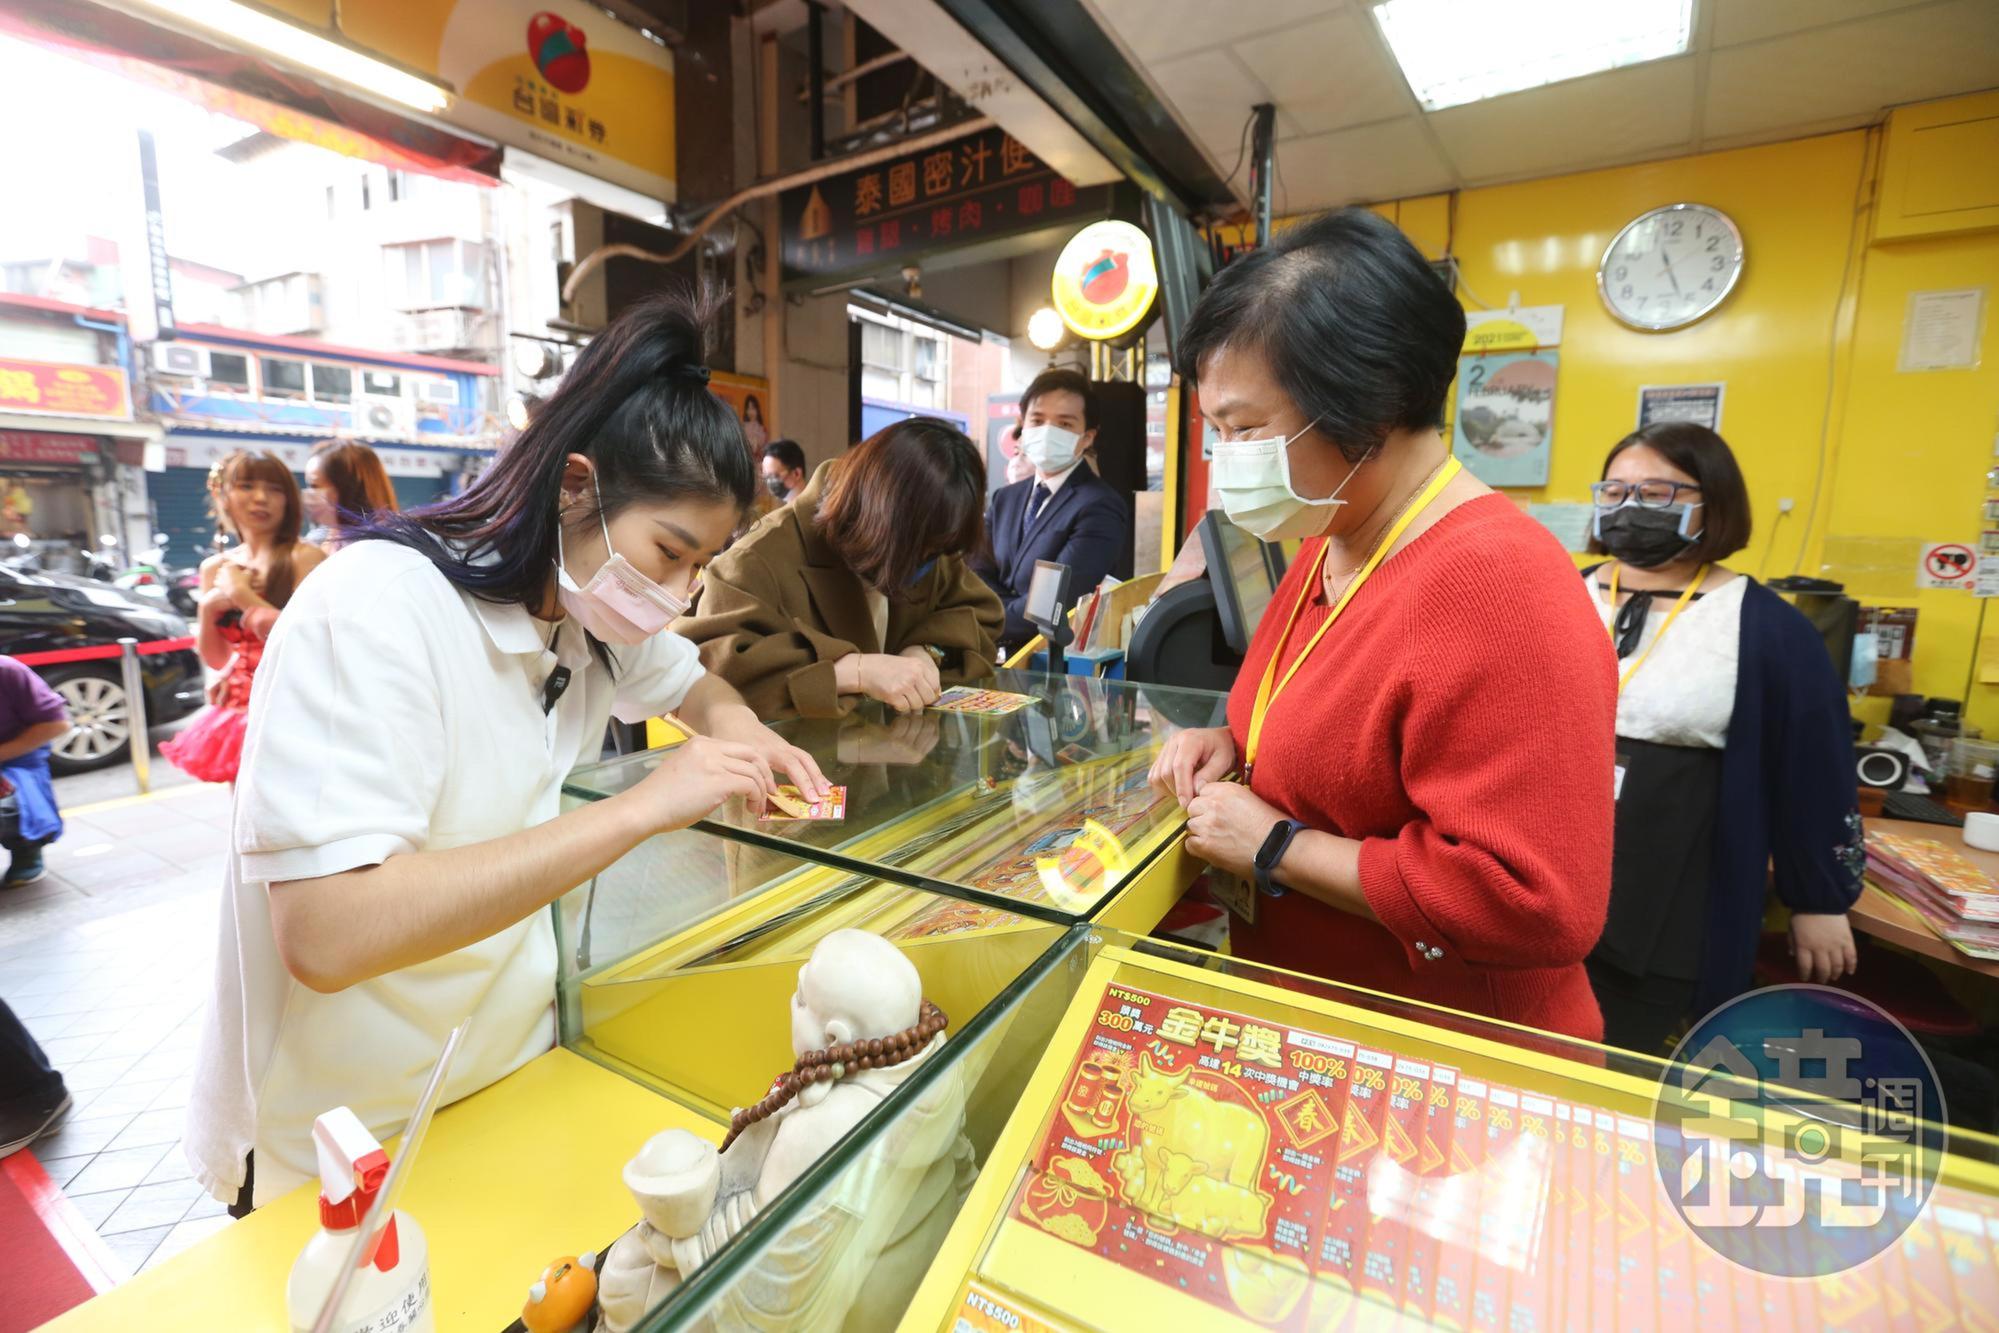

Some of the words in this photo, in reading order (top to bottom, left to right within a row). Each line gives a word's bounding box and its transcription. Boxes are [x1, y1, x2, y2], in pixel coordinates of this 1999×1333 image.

[1663, 220, 1684, 238] 12
[1695, 223, 1703, 239] 1
[1706, 235, 1720, 252] 2
[1614, 265, 1628, 281] 9
[1710, 256, 1726, 272] 3
[1700, 278, 1714, 296] 4
[1469, 365, 1486, 386] 2
[1109, 988, 1151, 1006] NT$500
[1156, 1007, 1282, 1068] 金牛獎
[1290, 1050, 1347, 1079] 100%
[1298, 1070, 1334, 1088] 中獎率
[1293, 1099, 1325, 1133] 春
[965, 1291, 1020, 1330] NT$500
